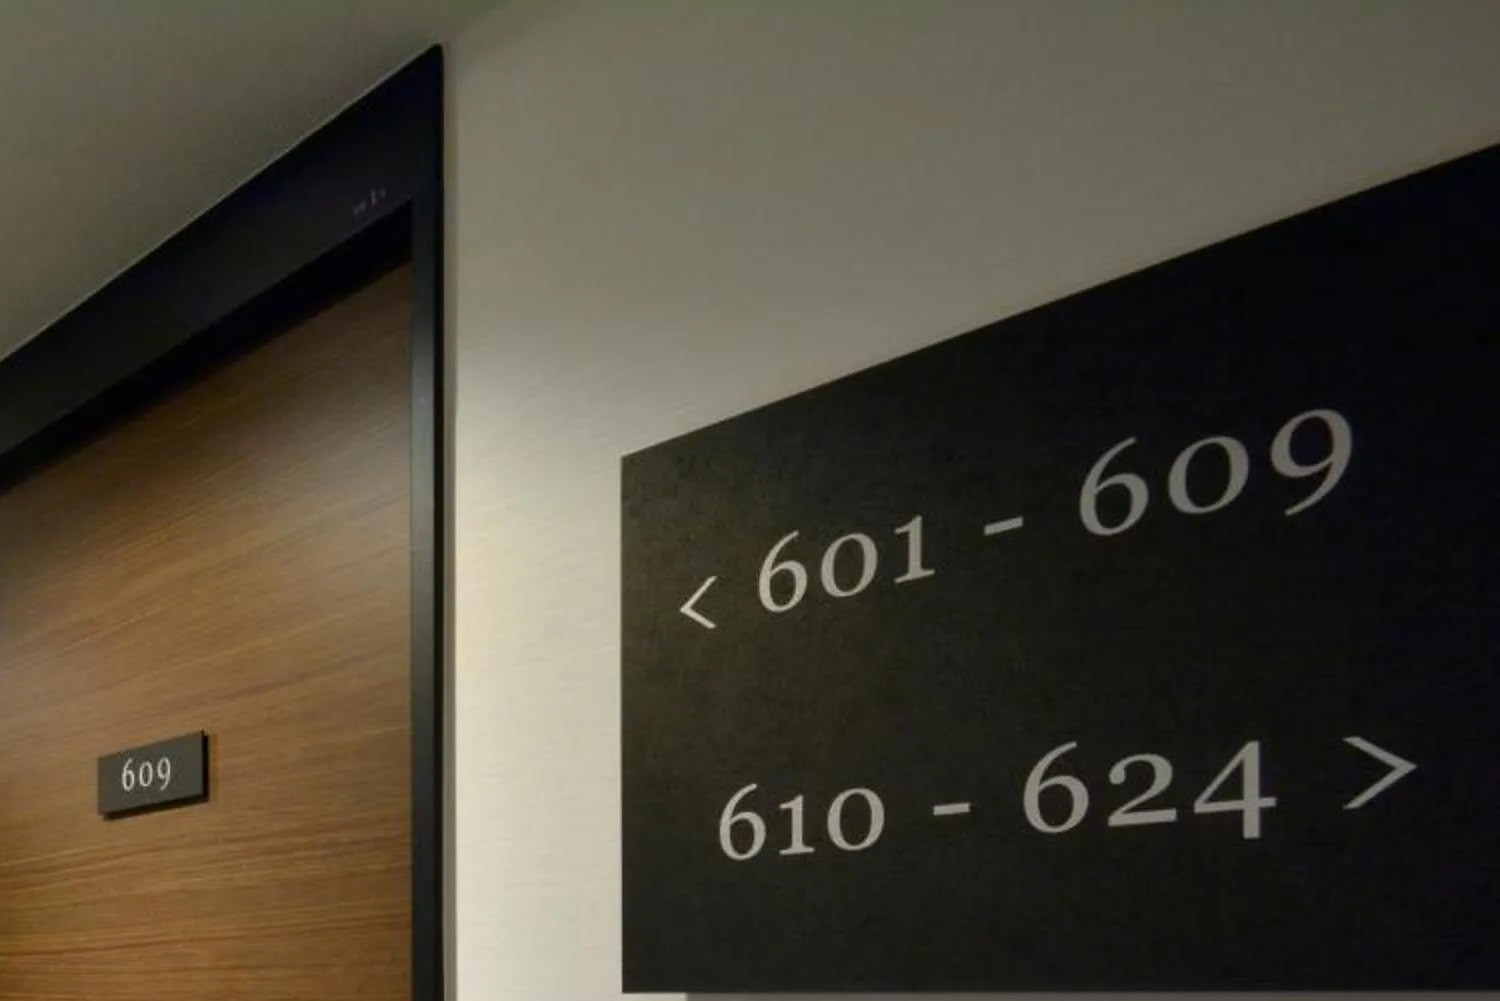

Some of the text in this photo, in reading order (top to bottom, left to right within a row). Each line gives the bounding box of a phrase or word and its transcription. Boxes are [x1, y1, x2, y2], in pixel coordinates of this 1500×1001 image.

[758, 515, 934, 612] 601
[1080, 410, 1351, 535] 609
[122, 757, 171, 792] 609
[719, 783, 885, 860] 610
[1023, 741, 1277, 839] 624
